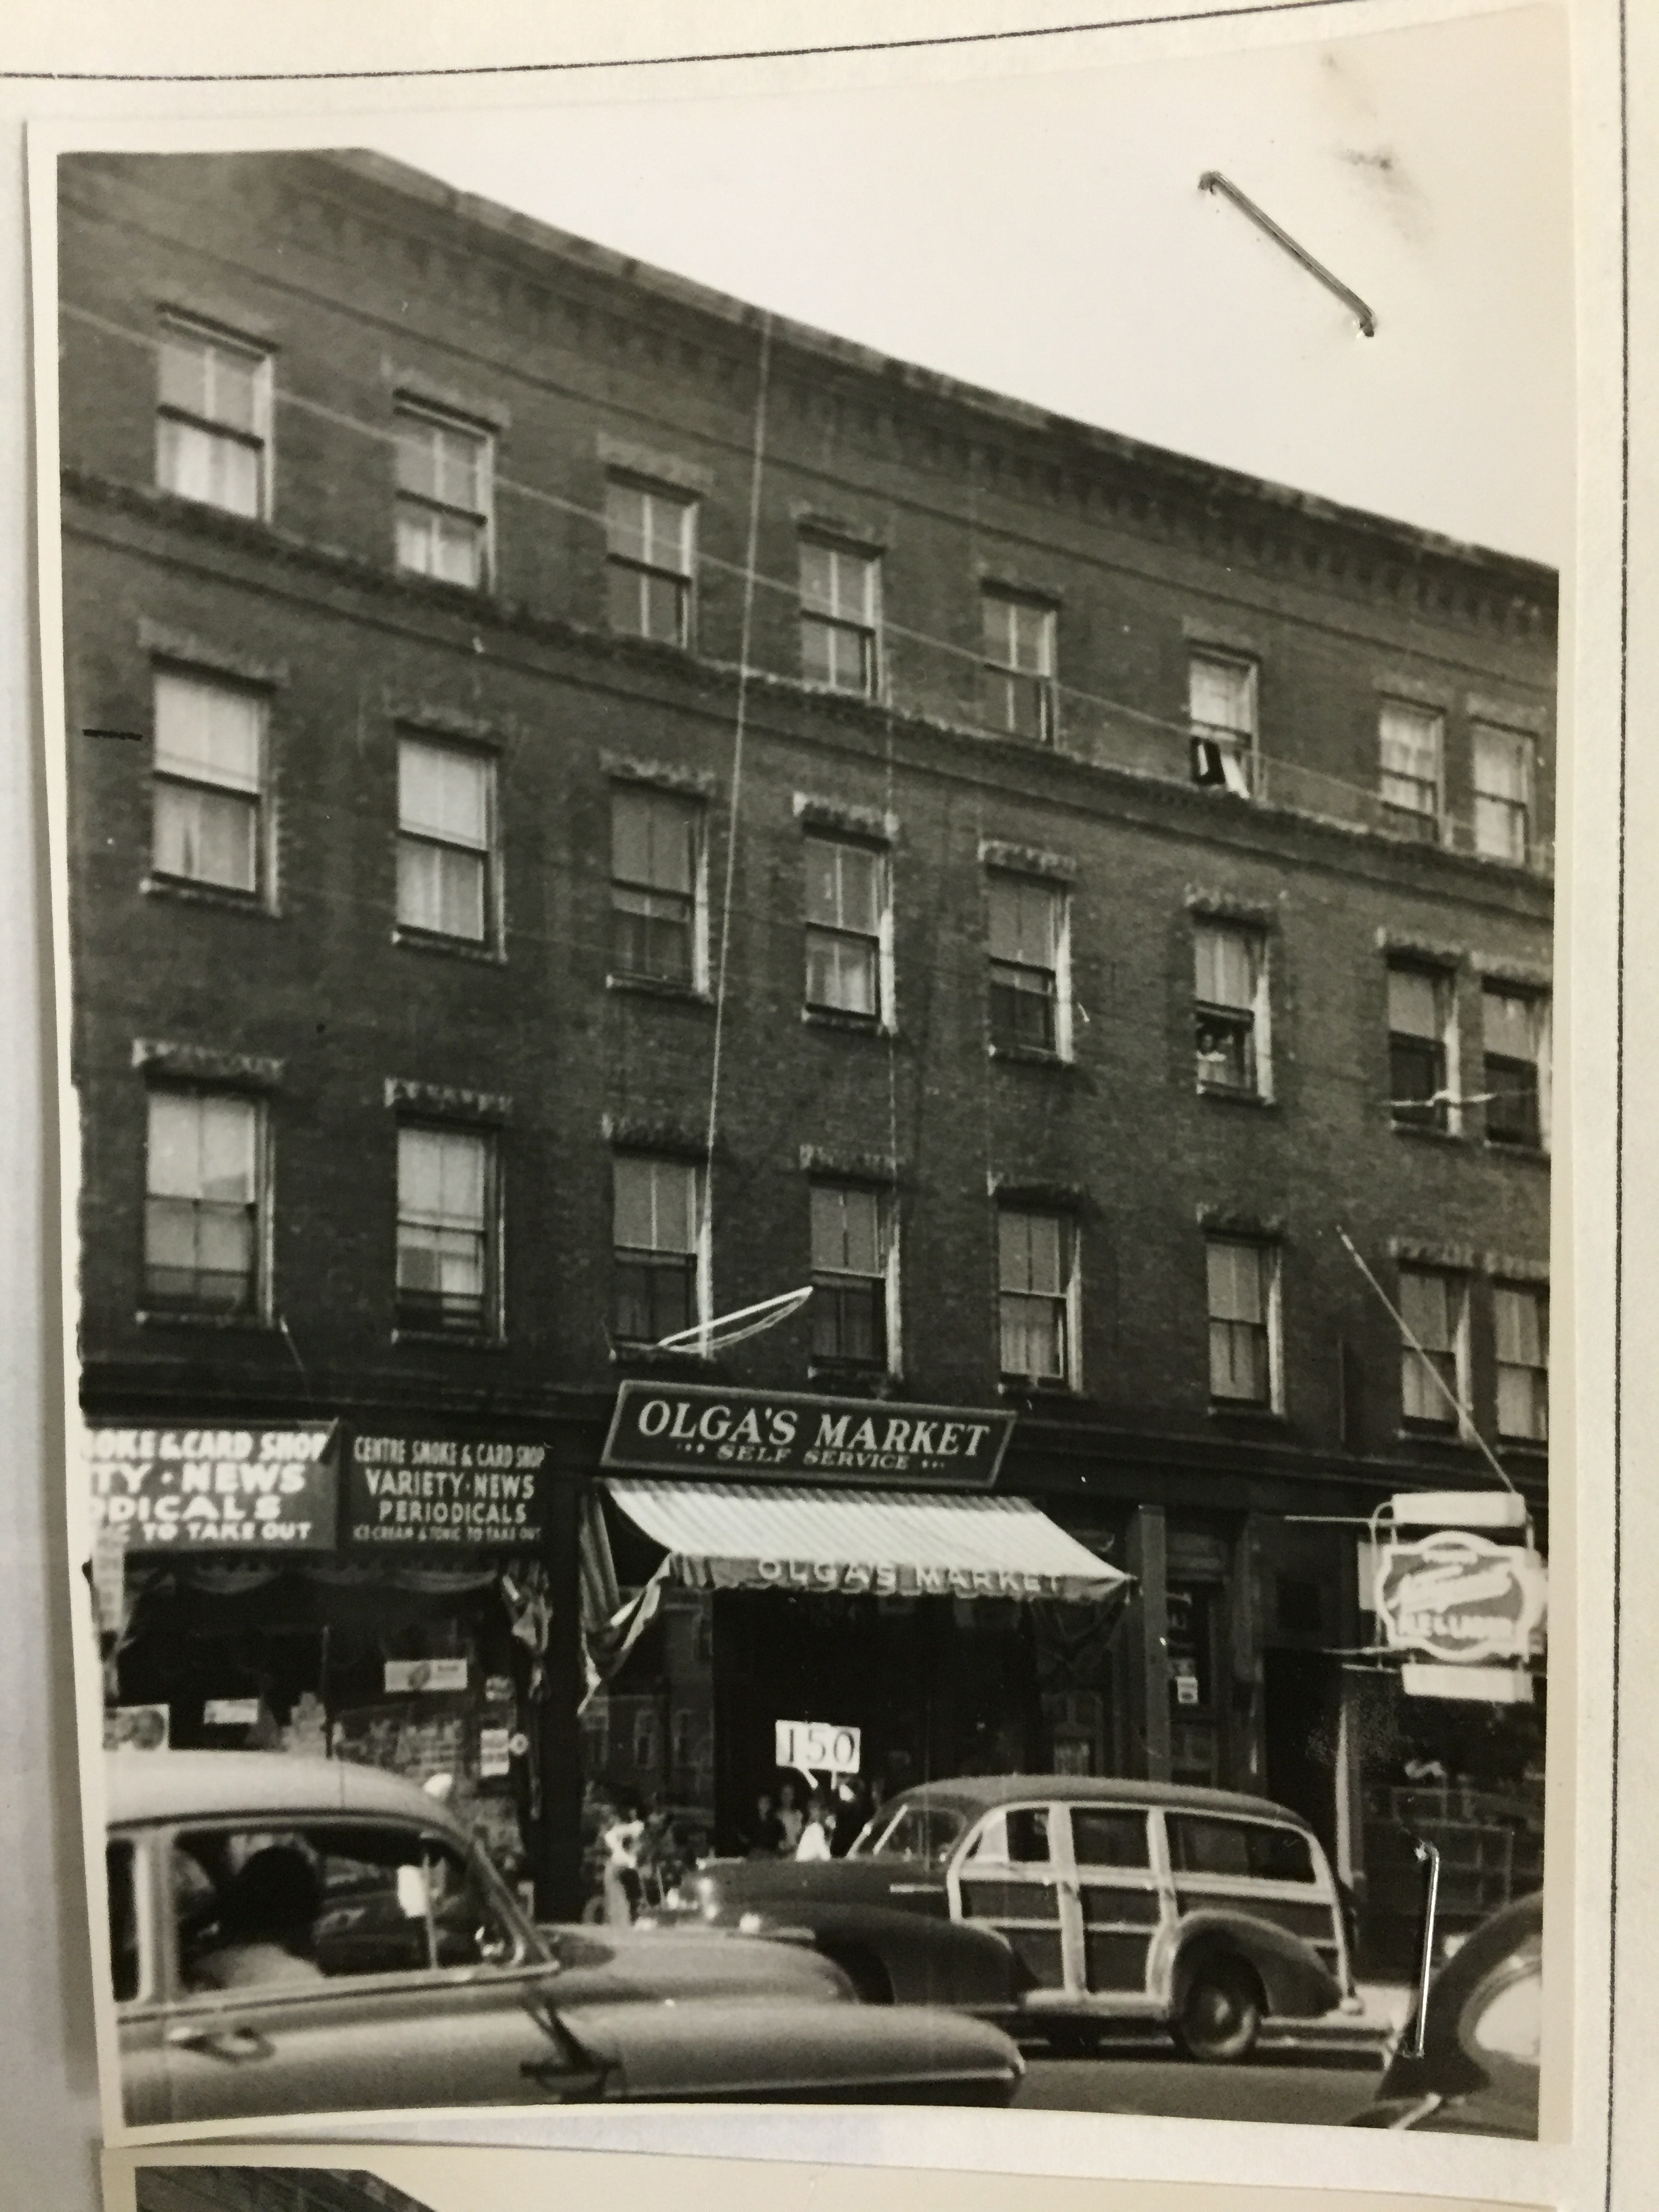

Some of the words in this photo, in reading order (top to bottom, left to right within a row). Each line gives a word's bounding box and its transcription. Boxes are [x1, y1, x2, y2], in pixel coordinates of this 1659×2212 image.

[638, 1399, 798, 1445] OLGA'S
[814, 1413, 990, 1456] MARKET
[91, 1430, 156, 1459] OKE
[717, 1443, 792, 1464] SELF
[803, 1450, 909, 1470] SERVICE
[365, 1469, 464, 1498] VARIETY
[474, 1473, 534, 1500] NEWS
[379, 1500, 527, 1524] PERIODICALS
[143, 1522, 178, 1541] TO
[188, 1521, 256, 1540] TAKE
[262, 1521, 312, 1540] OUT
[790, 1727, 855, 1765] 150
